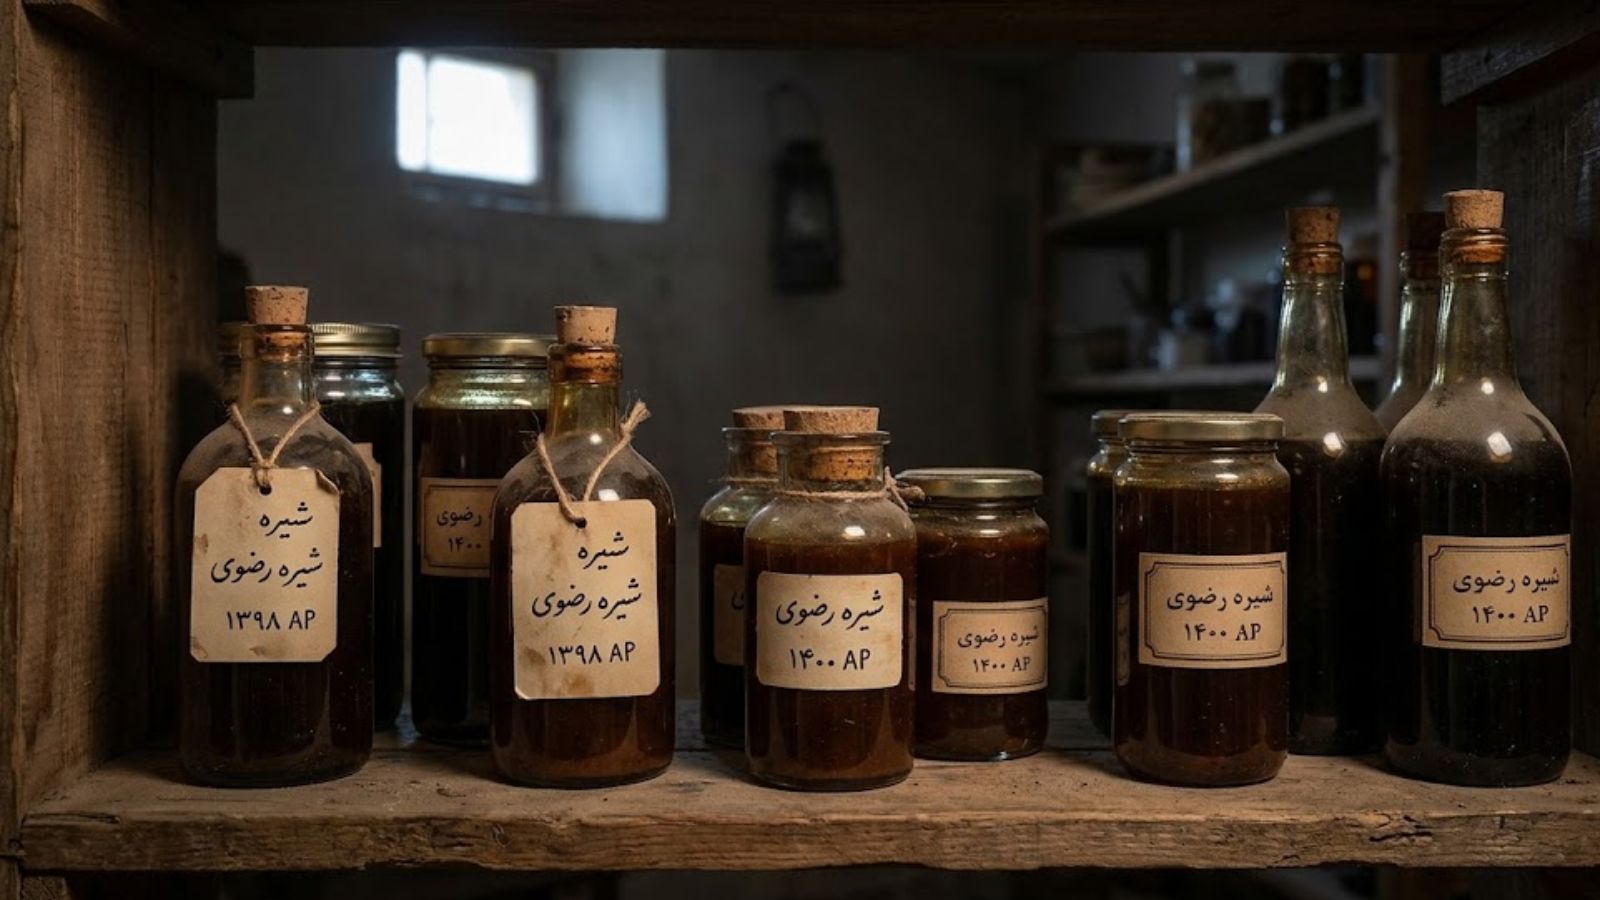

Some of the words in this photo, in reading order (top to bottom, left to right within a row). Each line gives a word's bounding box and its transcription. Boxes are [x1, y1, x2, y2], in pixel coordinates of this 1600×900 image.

[259, 501, 313, 538] شیره
[436, 506, 482, 527] رضوی
[577, 531, 629, 570] شیره
[210, 551, 272, 583] رضوی
[278, 547, 323, 588] شیره
[1453, 569, 1516, 594] رضوی
[1521, 567, 1560, 593] شیره
[531, 584, 592, 618] رضوی
[598, 578, 642, 620] شیره
[775, 593, 834, 626] رضوی
[841, 589, 885, 631] شیره
[1166, 587, 1227, 611] رضوی
[1233, 584, 1273, 611] شیره
[226, 611, 280, 630] ۱۳۹۸
[288, 609, 316, 630] AP
[1472, 605, 1516, 624] ۱۴۰۰
[1523, 605, 1549, 623] AP
[957, 628, 1006, 648] رضوی
[1010, 624, 1039, 647] شیره
[1184, 623, 1227, 641] ۱۴۰۰
[1235, 623, 1261, 641] AP
[549, 644, 602, 665] ۱۳۹۸
[609, 641, 636, 663] AP
[789, 649, 835, 670] ۱۴۰۰
[842, 648, 871, 670] AP
[973, 658, 1006, 672] ۱۴۰۰
[1011, 656, 1031, 672] AP
